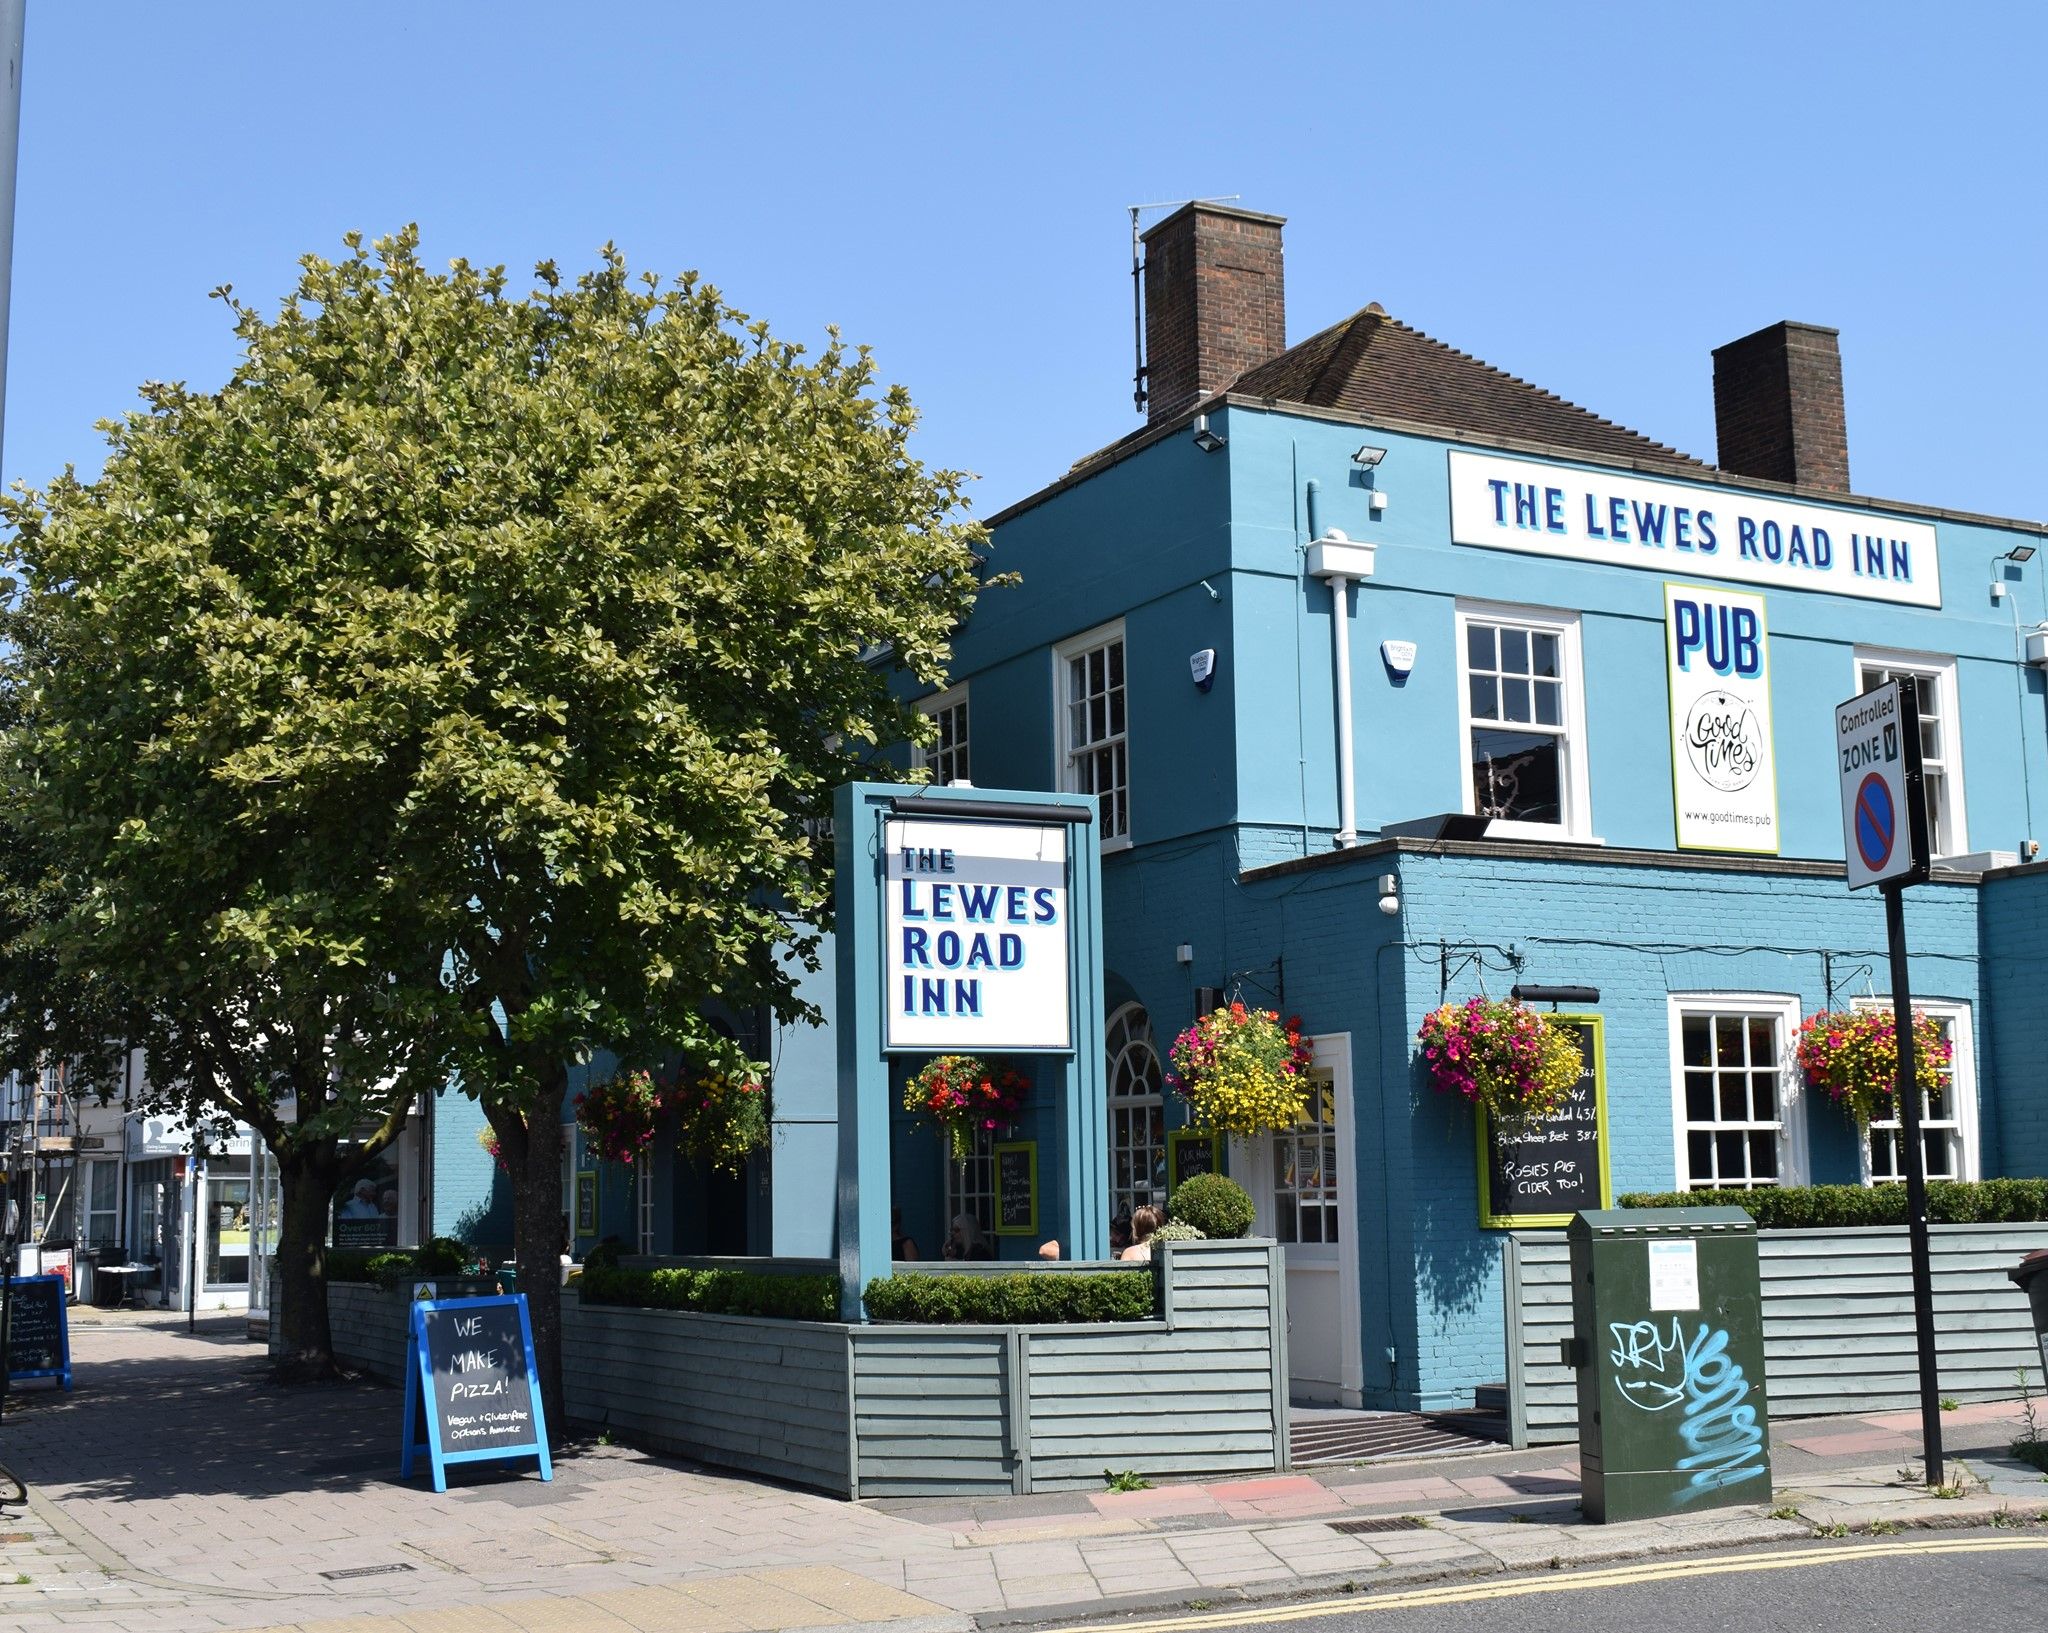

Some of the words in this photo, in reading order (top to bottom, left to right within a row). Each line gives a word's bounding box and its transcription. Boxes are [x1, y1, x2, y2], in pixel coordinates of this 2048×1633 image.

[1488, 479, 1567, 534] THE
[1585, 493, 1719, 554] LEWES
[1738, 516, 1833, 571] ROAD
[1851, 533, 1913, 583] INN
[1674, 599, 1764, 679] PUB
[1697, 709, 1747, 744] Good
[1840, 693, 1894, 734] Controlled
[1843, 736, 1880, 773] ZONE
[1885, 728, 1895, 755] V
[1685, 810, 1771, 827] www.goodtimes.pub
[901, 847, 955, 873] THE
[902, 878, 1058, 926] LEWES
[903, 926, 1026, 971] ROAD
[903, 975, 983, 1017] INN
[1522, 1131, 1547, 1144] Sheep
[1548, 1130, 1569, 1142] Best
[1553, 1160, 1576, 1173] PIG
[1517, 1180, 1552, 1195] CIDER
[454, 1316, 482, 1337] WE
[449, 1348, 498, 1375] MAKE
[447, 1414, 477, 1427] Vegan
